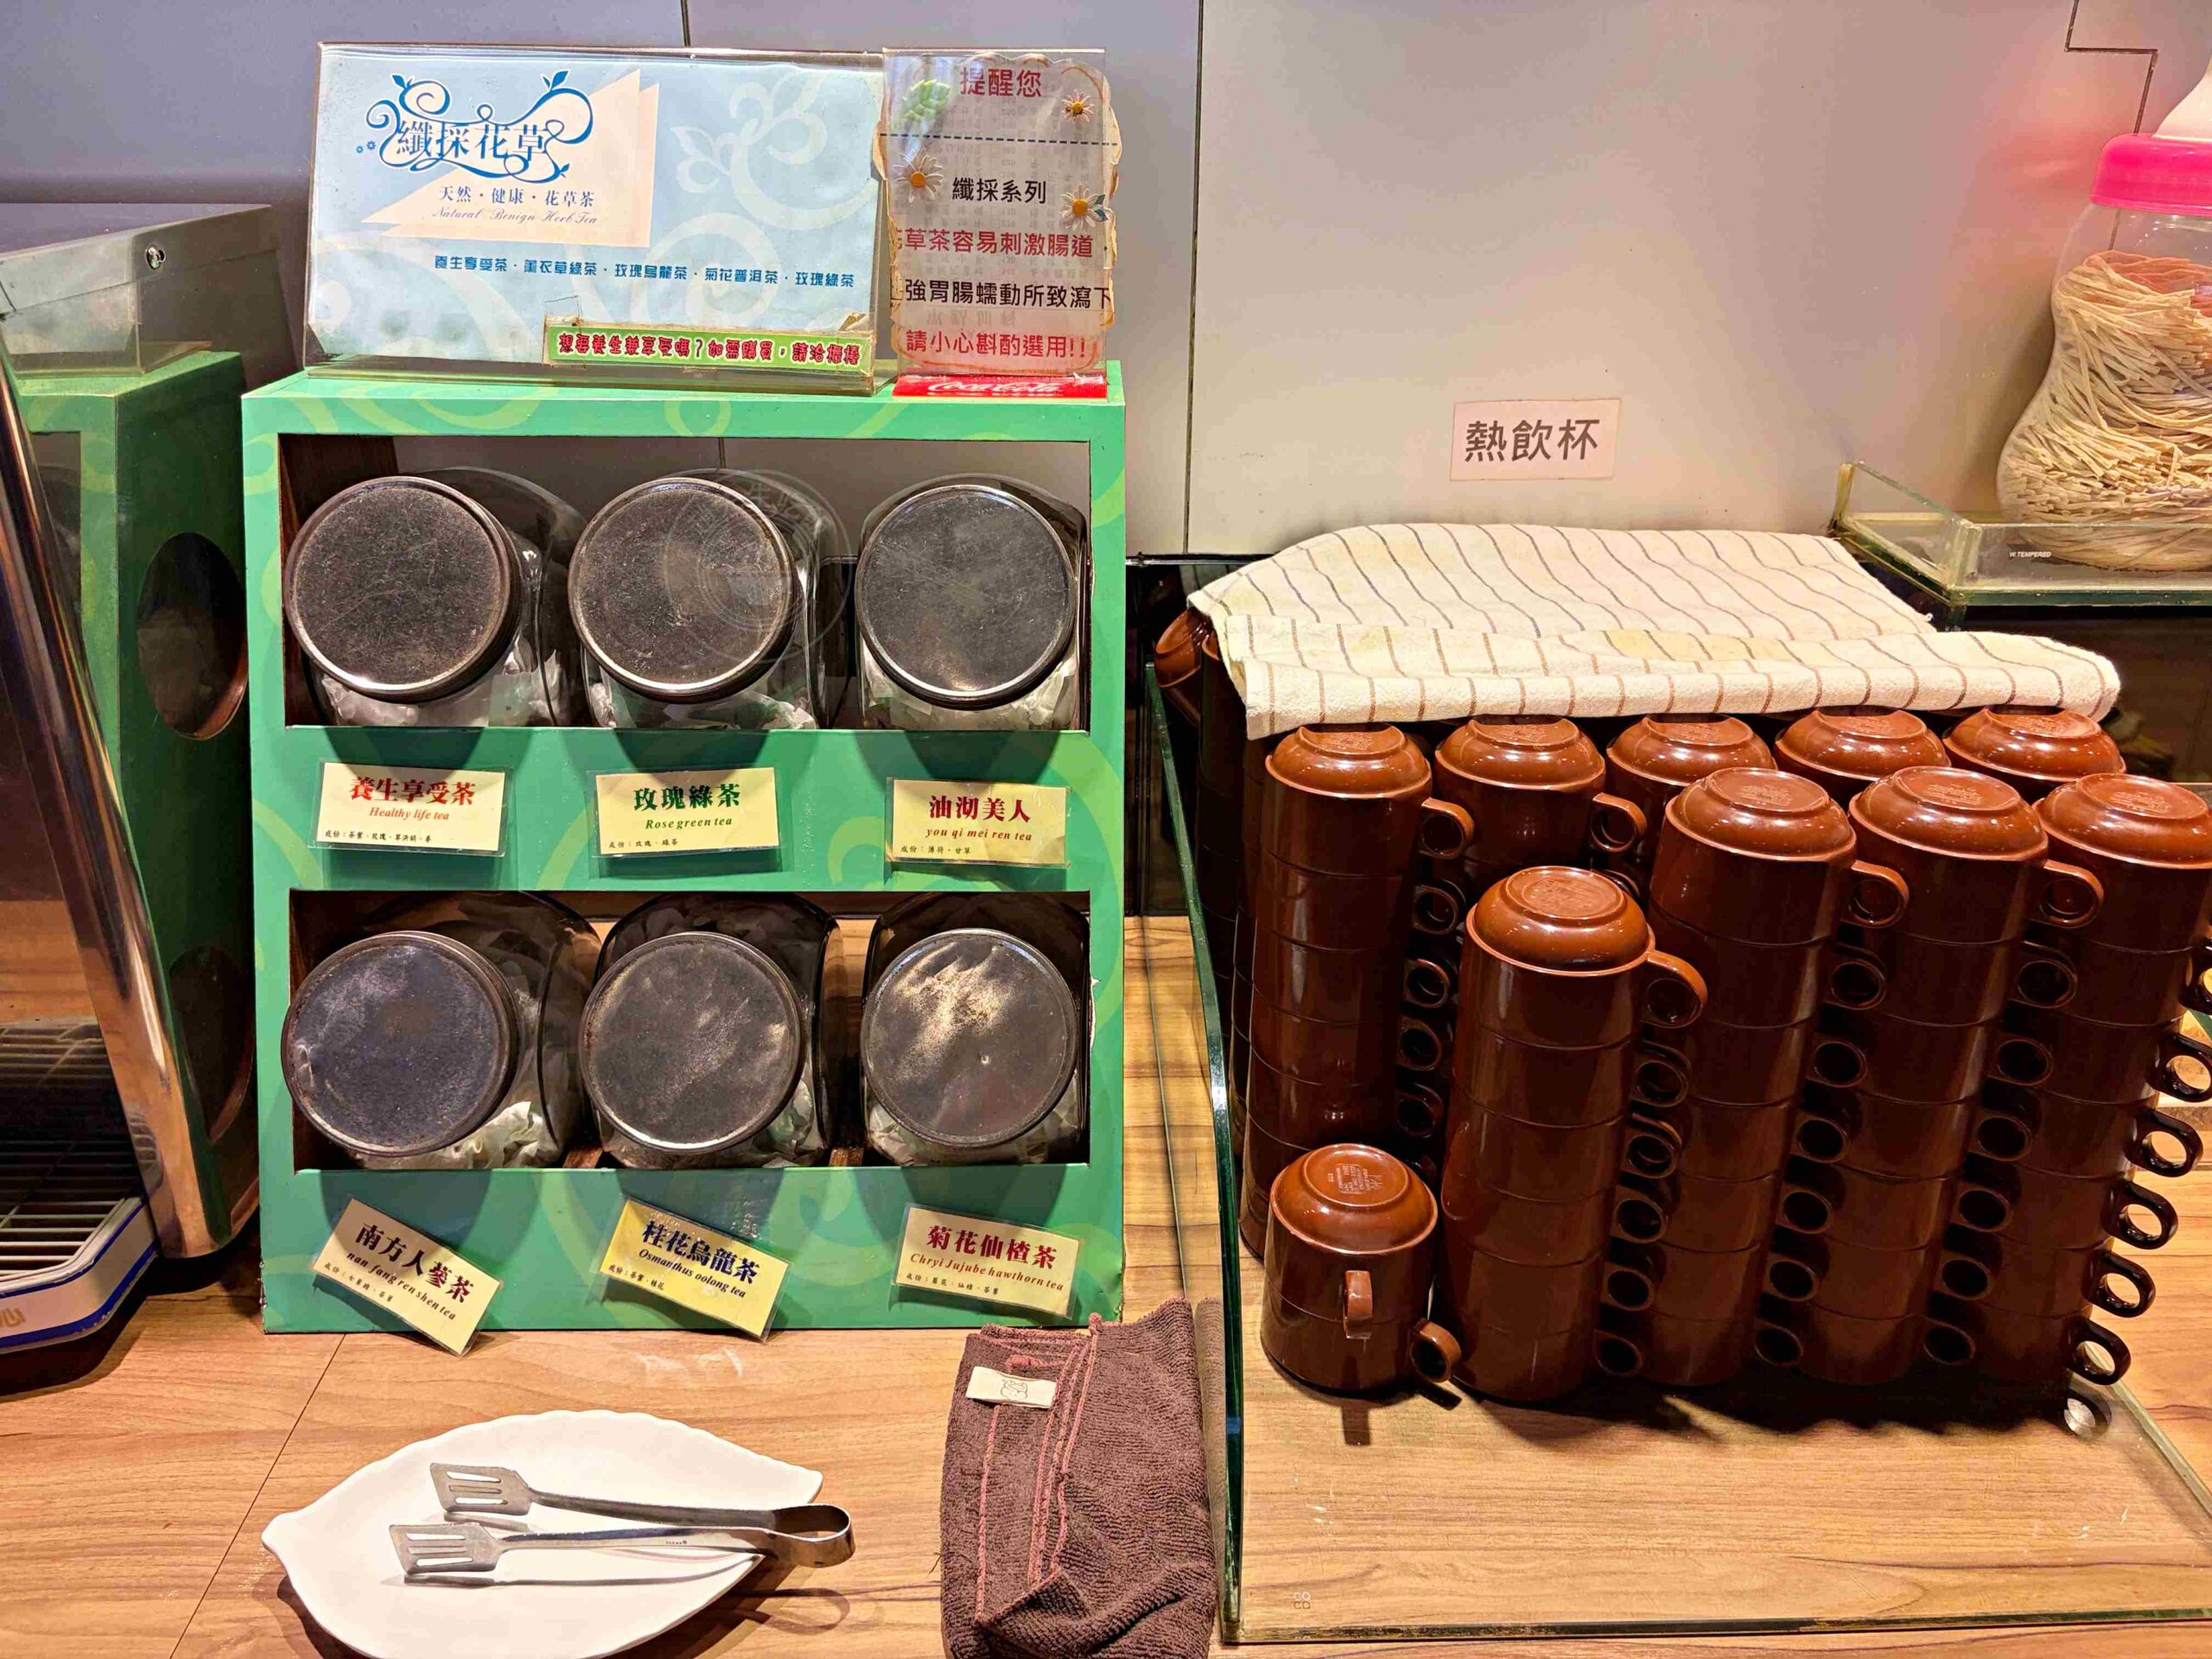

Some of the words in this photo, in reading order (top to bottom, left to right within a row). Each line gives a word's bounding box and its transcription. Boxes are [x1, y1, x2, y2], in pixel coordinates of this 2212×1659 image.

[959, 67, 1042, 98] 提醒您
[396, 121, 548, 162] 纖採花草
[952, 178, 1046, 204] 纖採系列
[432, 207, 483, 219] Natural
[490, 209, 536, 224] Benign
[542, 210, 574, 223] Herb
[575, 212, 597, 224] Tea
[898, 278, 1112, 309] 強胃腸蠕動所致瀉下
[1465, 419, 1600, 462] 熱飲杯
[349, 777, 476, 806] 養生享受茶
[633, 784, 741, 811] 玫瑰綠茶
[369, 807, 411, 820] Healthy
[414, 809, 431, 820] life
[433, 811, 449, 820] tea
[645, 819, 674, 830] Rose
[675, 818, 711, 830] green
[714, 817, 733, 826] tea
[929, 795, 1031, 823] 油沏美人
[925, 829, 947, 838] you
[951, 827, 963, 840] qi
[967, 828, 988, 839] mei
[992, 831, 1010, 841] ren
[1014, 832, 1032, 842] tea
[355, 1222, 474, 1303] 南方人蔘茶
[642, 1219, 760, 1285] 桂花烏龍茶
[925, 1224, 1058, 1270] 菊花仙楂茶
[346, 1251, 368, 1267] nan
[367, 1264, 397, 1286] fang
[397, 1279, 421, 1294] ren
[416, 1290, 439, 1308] shen
[439, 1306, 456, 1320] tea
[639, 1249, 695, 1276] Osmanthus
[695, 1273, 729, 1293] oolong
[730, 1286, 747, 1299] tea
[910, 1253, 944, 1269] Chryi
[944, 1260, 985, 1275] Jujube
[988, 1264, 1044, 1287] hawthorn
[1046, 1280, 1064, 1291] tea
